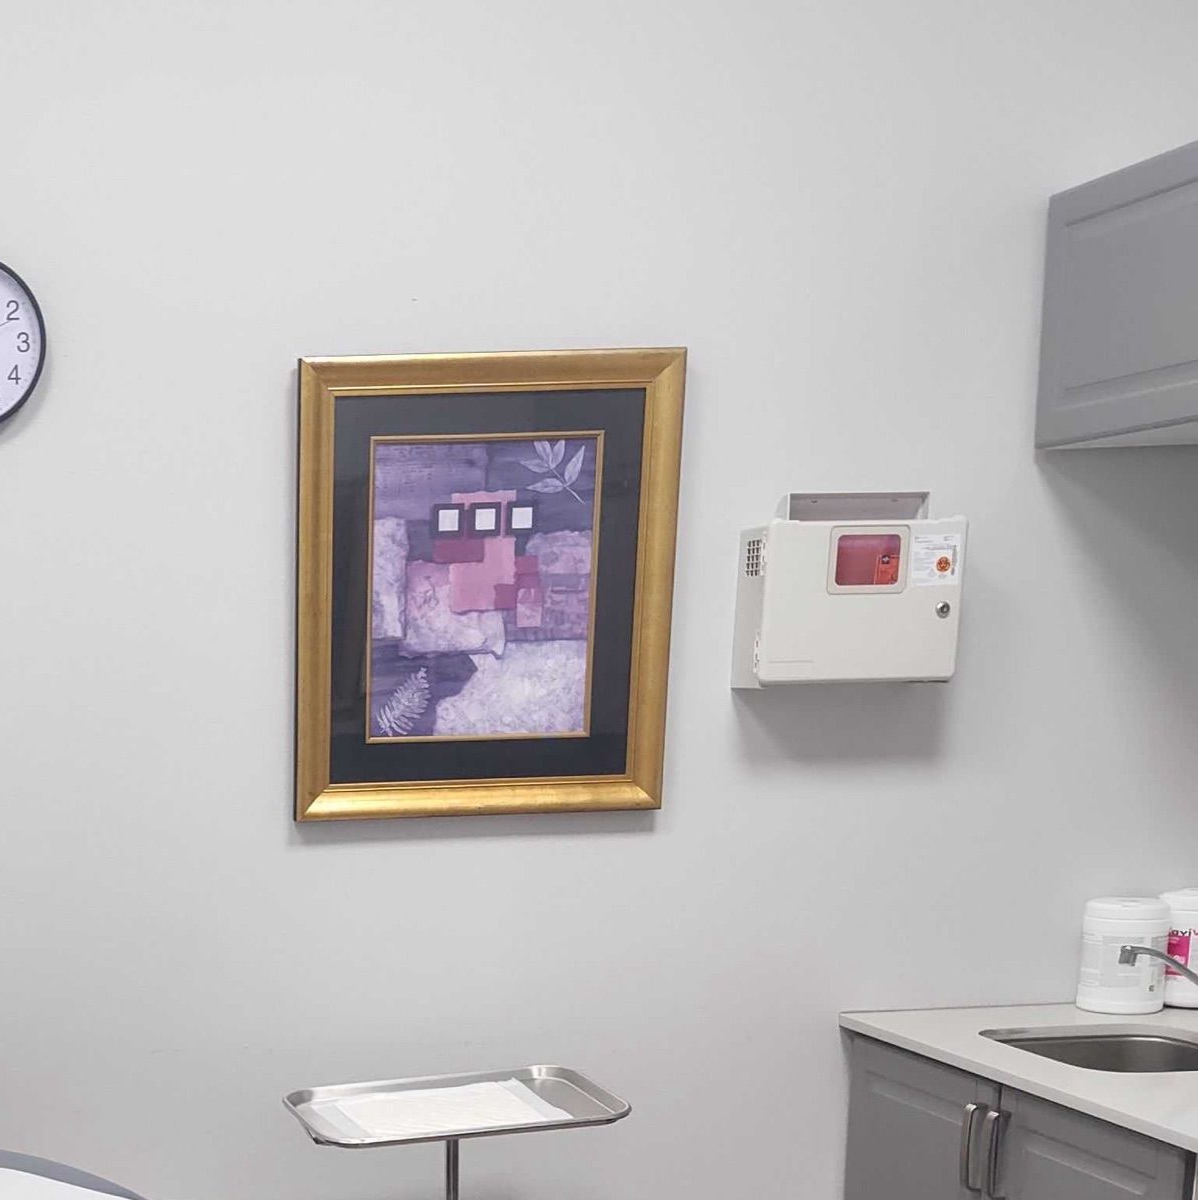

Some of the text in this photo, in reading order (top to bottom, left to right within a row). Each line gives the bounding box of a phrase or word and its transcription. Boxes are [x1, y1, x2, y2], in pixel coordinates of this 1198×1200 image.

[6, 300, 20, 321] 2
[16, 332, 30, 353] 3
[7, 364, 22, 385] 4
